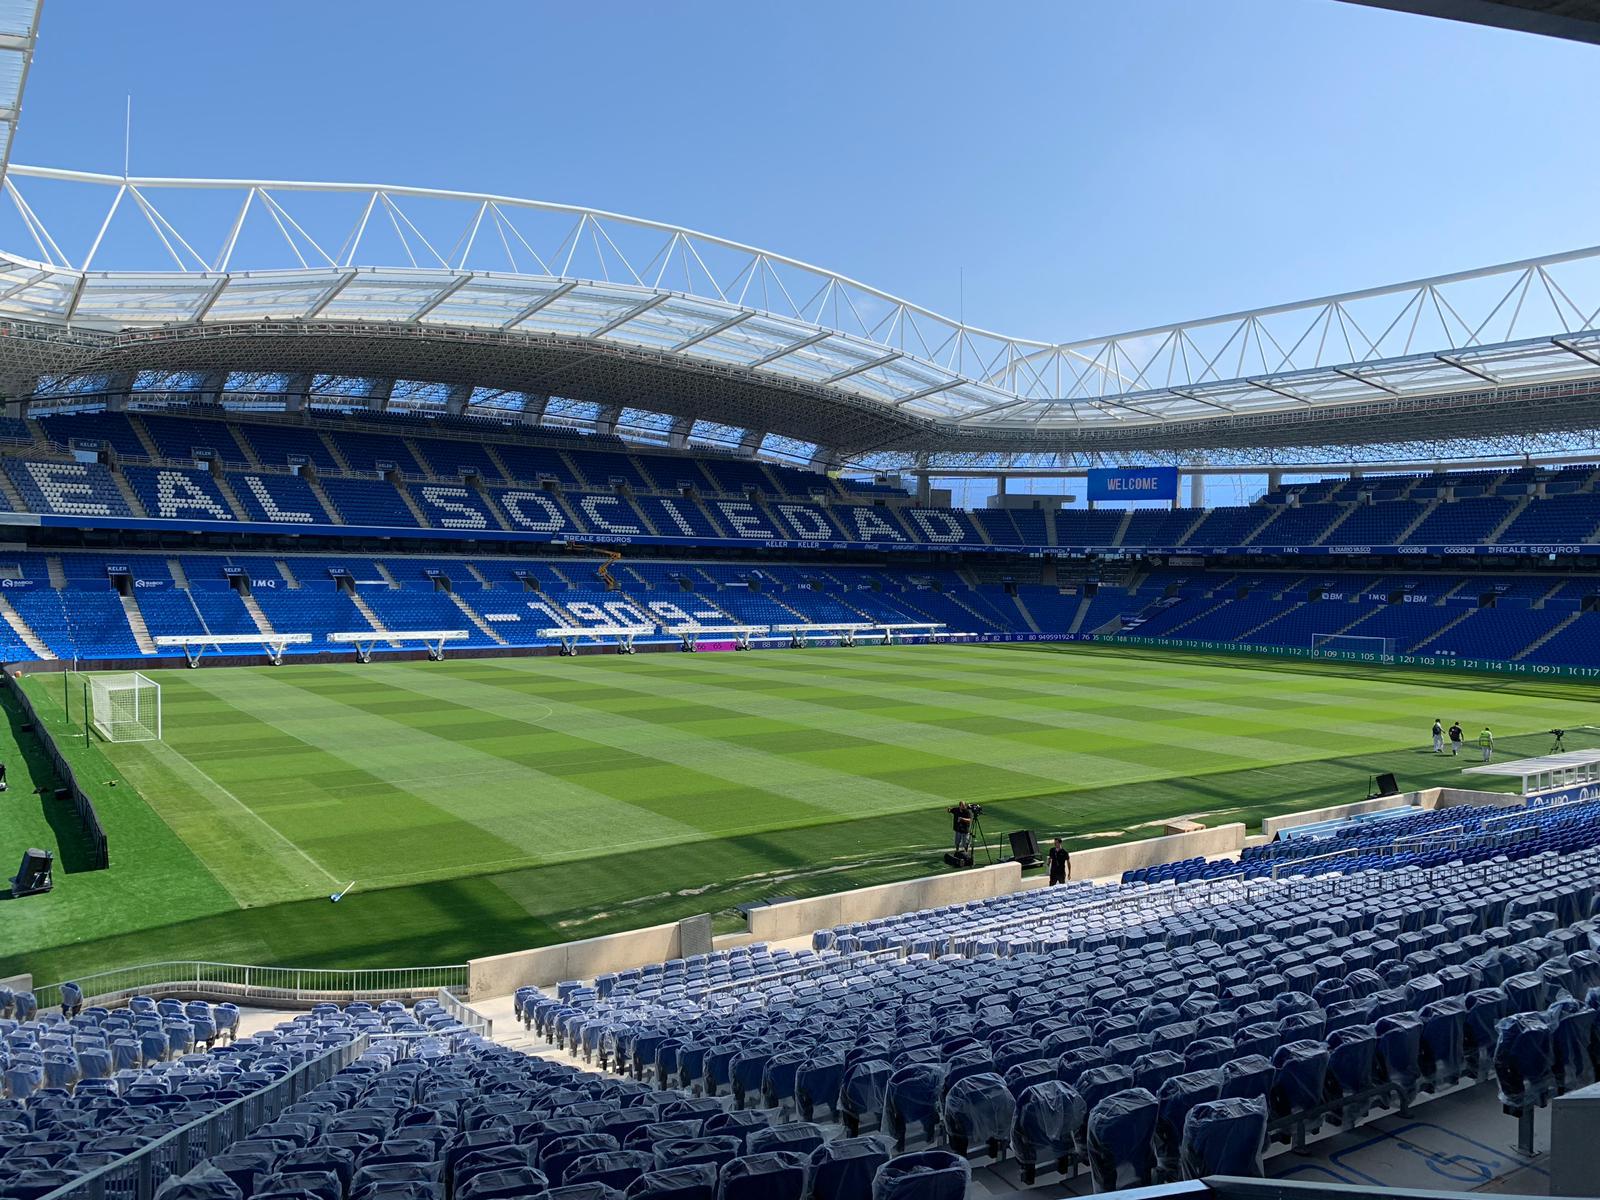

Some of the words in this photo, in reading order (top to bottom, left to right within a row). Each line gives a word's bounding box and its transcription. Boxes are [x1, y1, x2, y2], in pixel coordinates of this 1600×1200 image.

[1107, 477, 1158, 490] WELCOME
[421, 486, 966, 543] SOCIEDAD
[569, 535, 594, 543] REALE
[596, 536, 633, 544] SEGUROS
[1530, 546, 1580, 554] SEGUROS
[253, 579, 276, 589] IMQ
[1368, 593, 1387, 602] IMQ
[1341, 651, 1356, 659] 113
[1361, 653, 1375, 661] 105
[1420, 657, 1435, 665] 103
[1441, 658, 1456, 667] 115
[1462, 660, 1478, 668] 121
[1485, 661, 1503, 670] 114
[1508, 663, 1526, 672] 114
[1532, 665, 1550, 673] 109
[1581, 668, 1600, 677] 117
